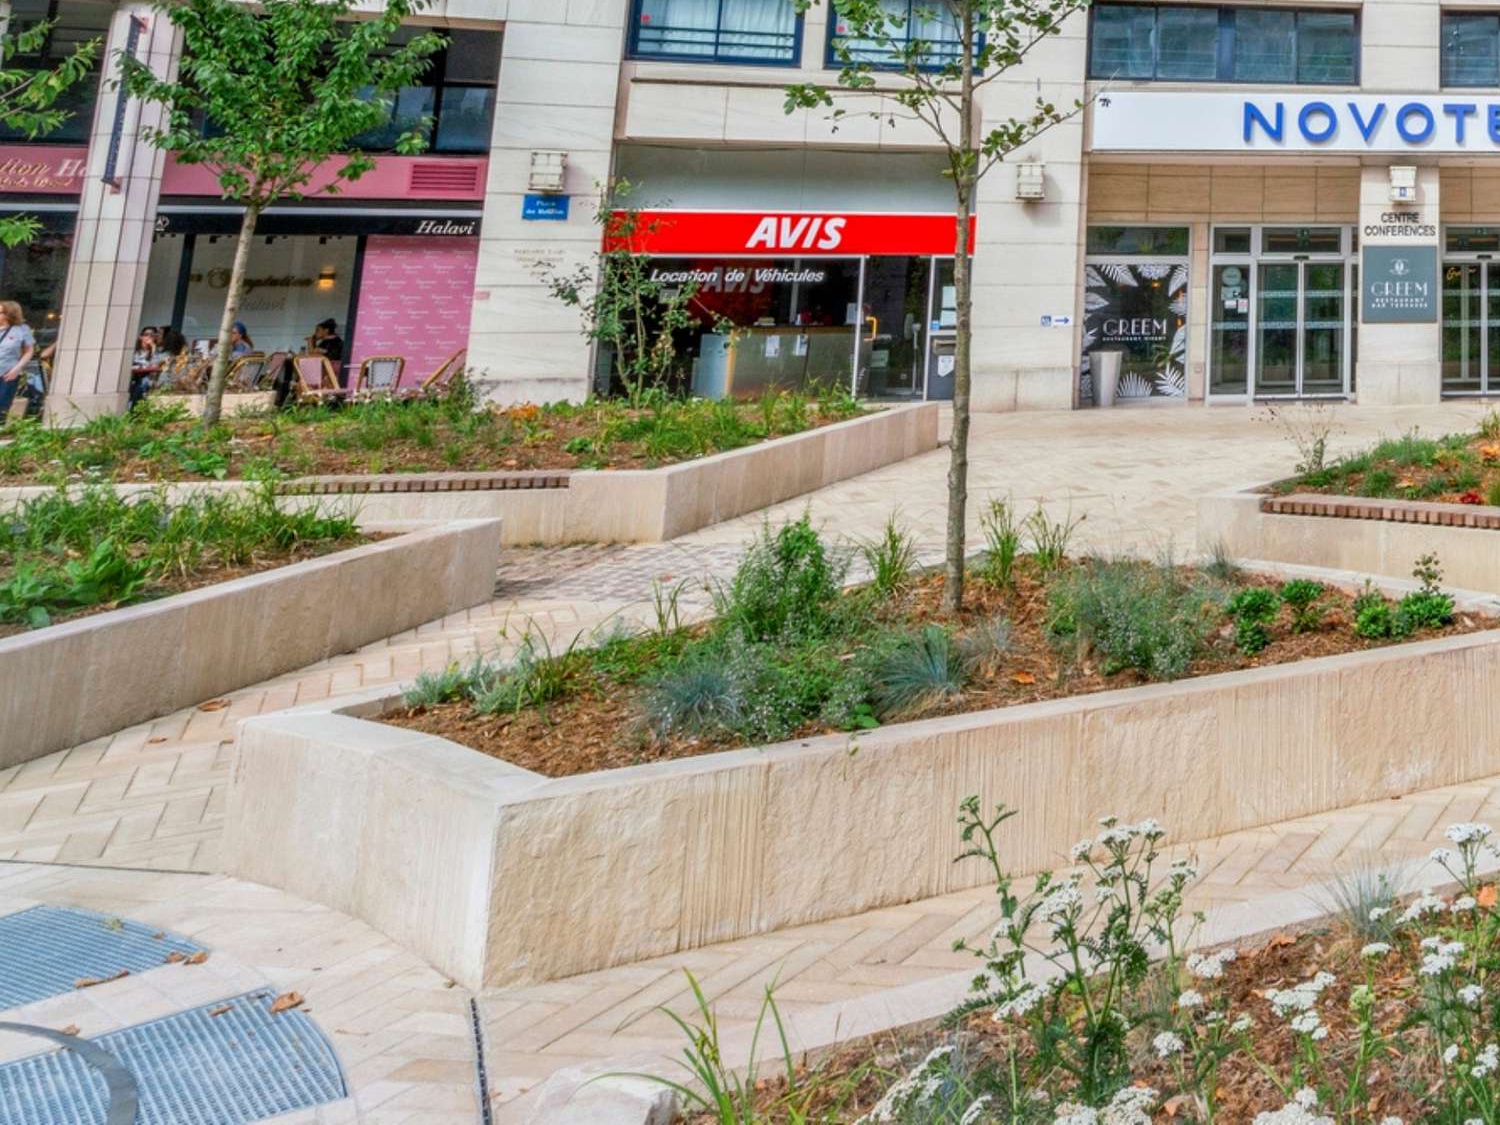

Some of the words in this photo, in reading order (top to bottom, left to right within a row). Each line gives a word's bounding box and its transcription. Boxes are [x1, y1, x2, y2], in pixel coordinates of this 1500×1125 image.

[1381, 212, 1420, 224] CENTRE
[416, 220, 475, 235] Halavi
[745, 217, 847, 250] AVIS
[1364, 225, 1436, 237] CONFERENCES
[651, 268, 718, 283] Location
[724, 268, 745, 283] de
[754, 267, 825, 283] Véhicules
[1370, 281, 1428, 297] GREEM
[1102, 318, 1167, 336] GREEM
